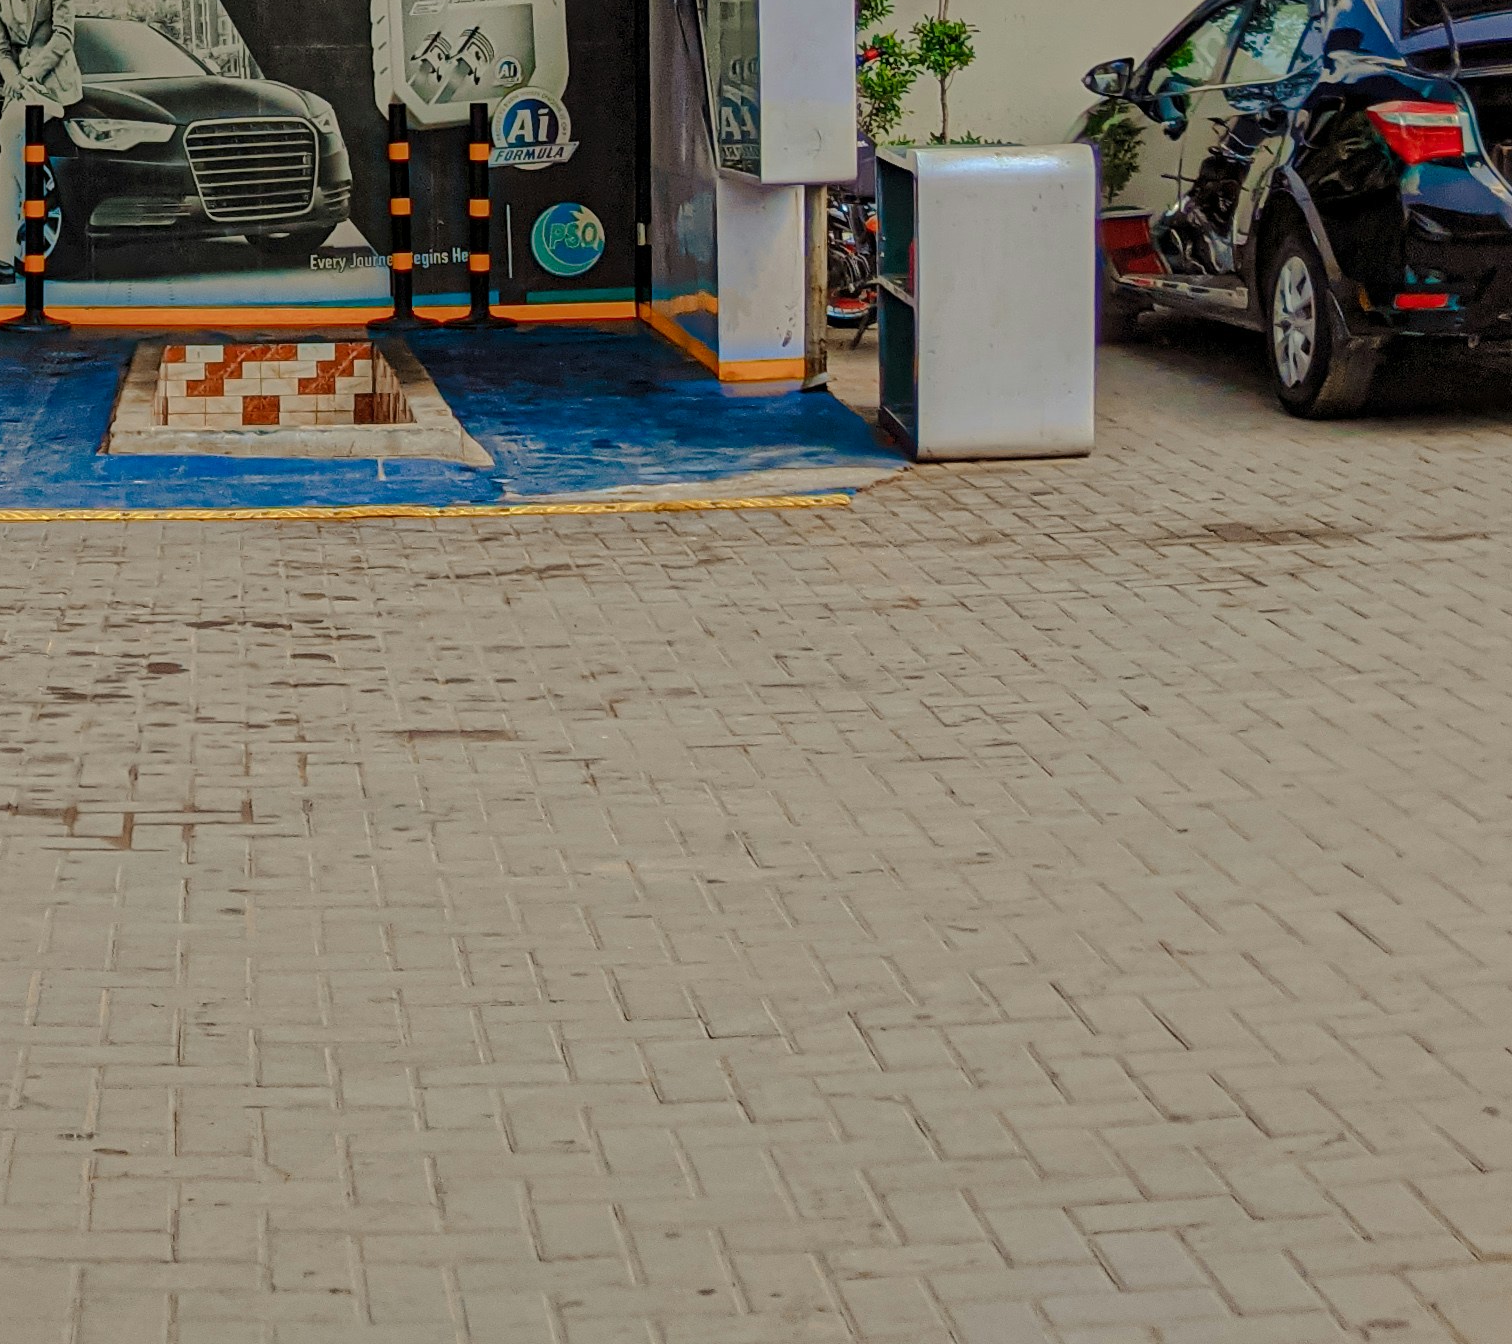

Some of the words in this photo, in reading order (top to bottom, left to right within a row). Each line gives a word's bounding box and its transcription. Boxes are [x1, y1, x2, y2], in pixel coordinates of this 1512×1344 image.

[495, 147, 565, 162] FORMULA
[549, 221, 598, 250] PSO
[310, 254, 346, 272] Every
[350, 255, 394, 269] Journe
[410, 249, 449, 268] egins
